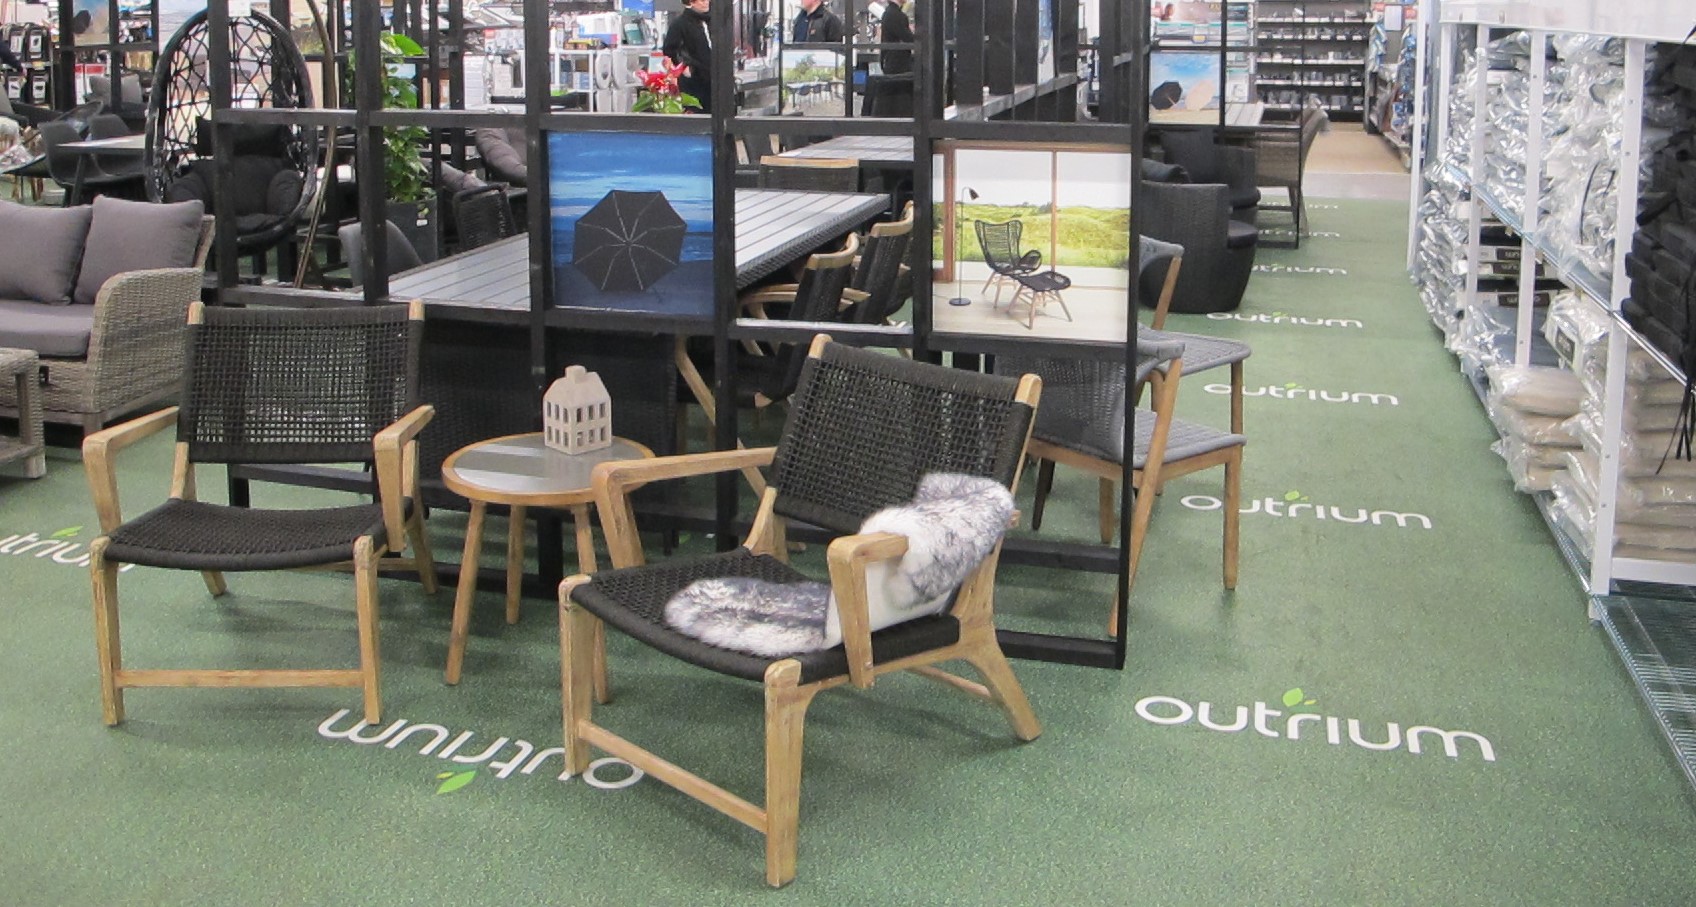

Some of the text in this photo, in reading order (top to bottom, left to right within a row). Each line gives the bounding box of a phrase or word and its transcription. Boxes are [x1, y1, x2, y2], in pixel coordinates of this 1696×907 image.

[1251, 264, 1348, 275] trium
[1206, 313, 1363, 329] outrium
[1203, 384, 1399, 408] outrium
[1180, 496, 1432, 530] outrium
[1135, 695, 1496, 762] outrium
[317, 708, 646, 790] outrium
